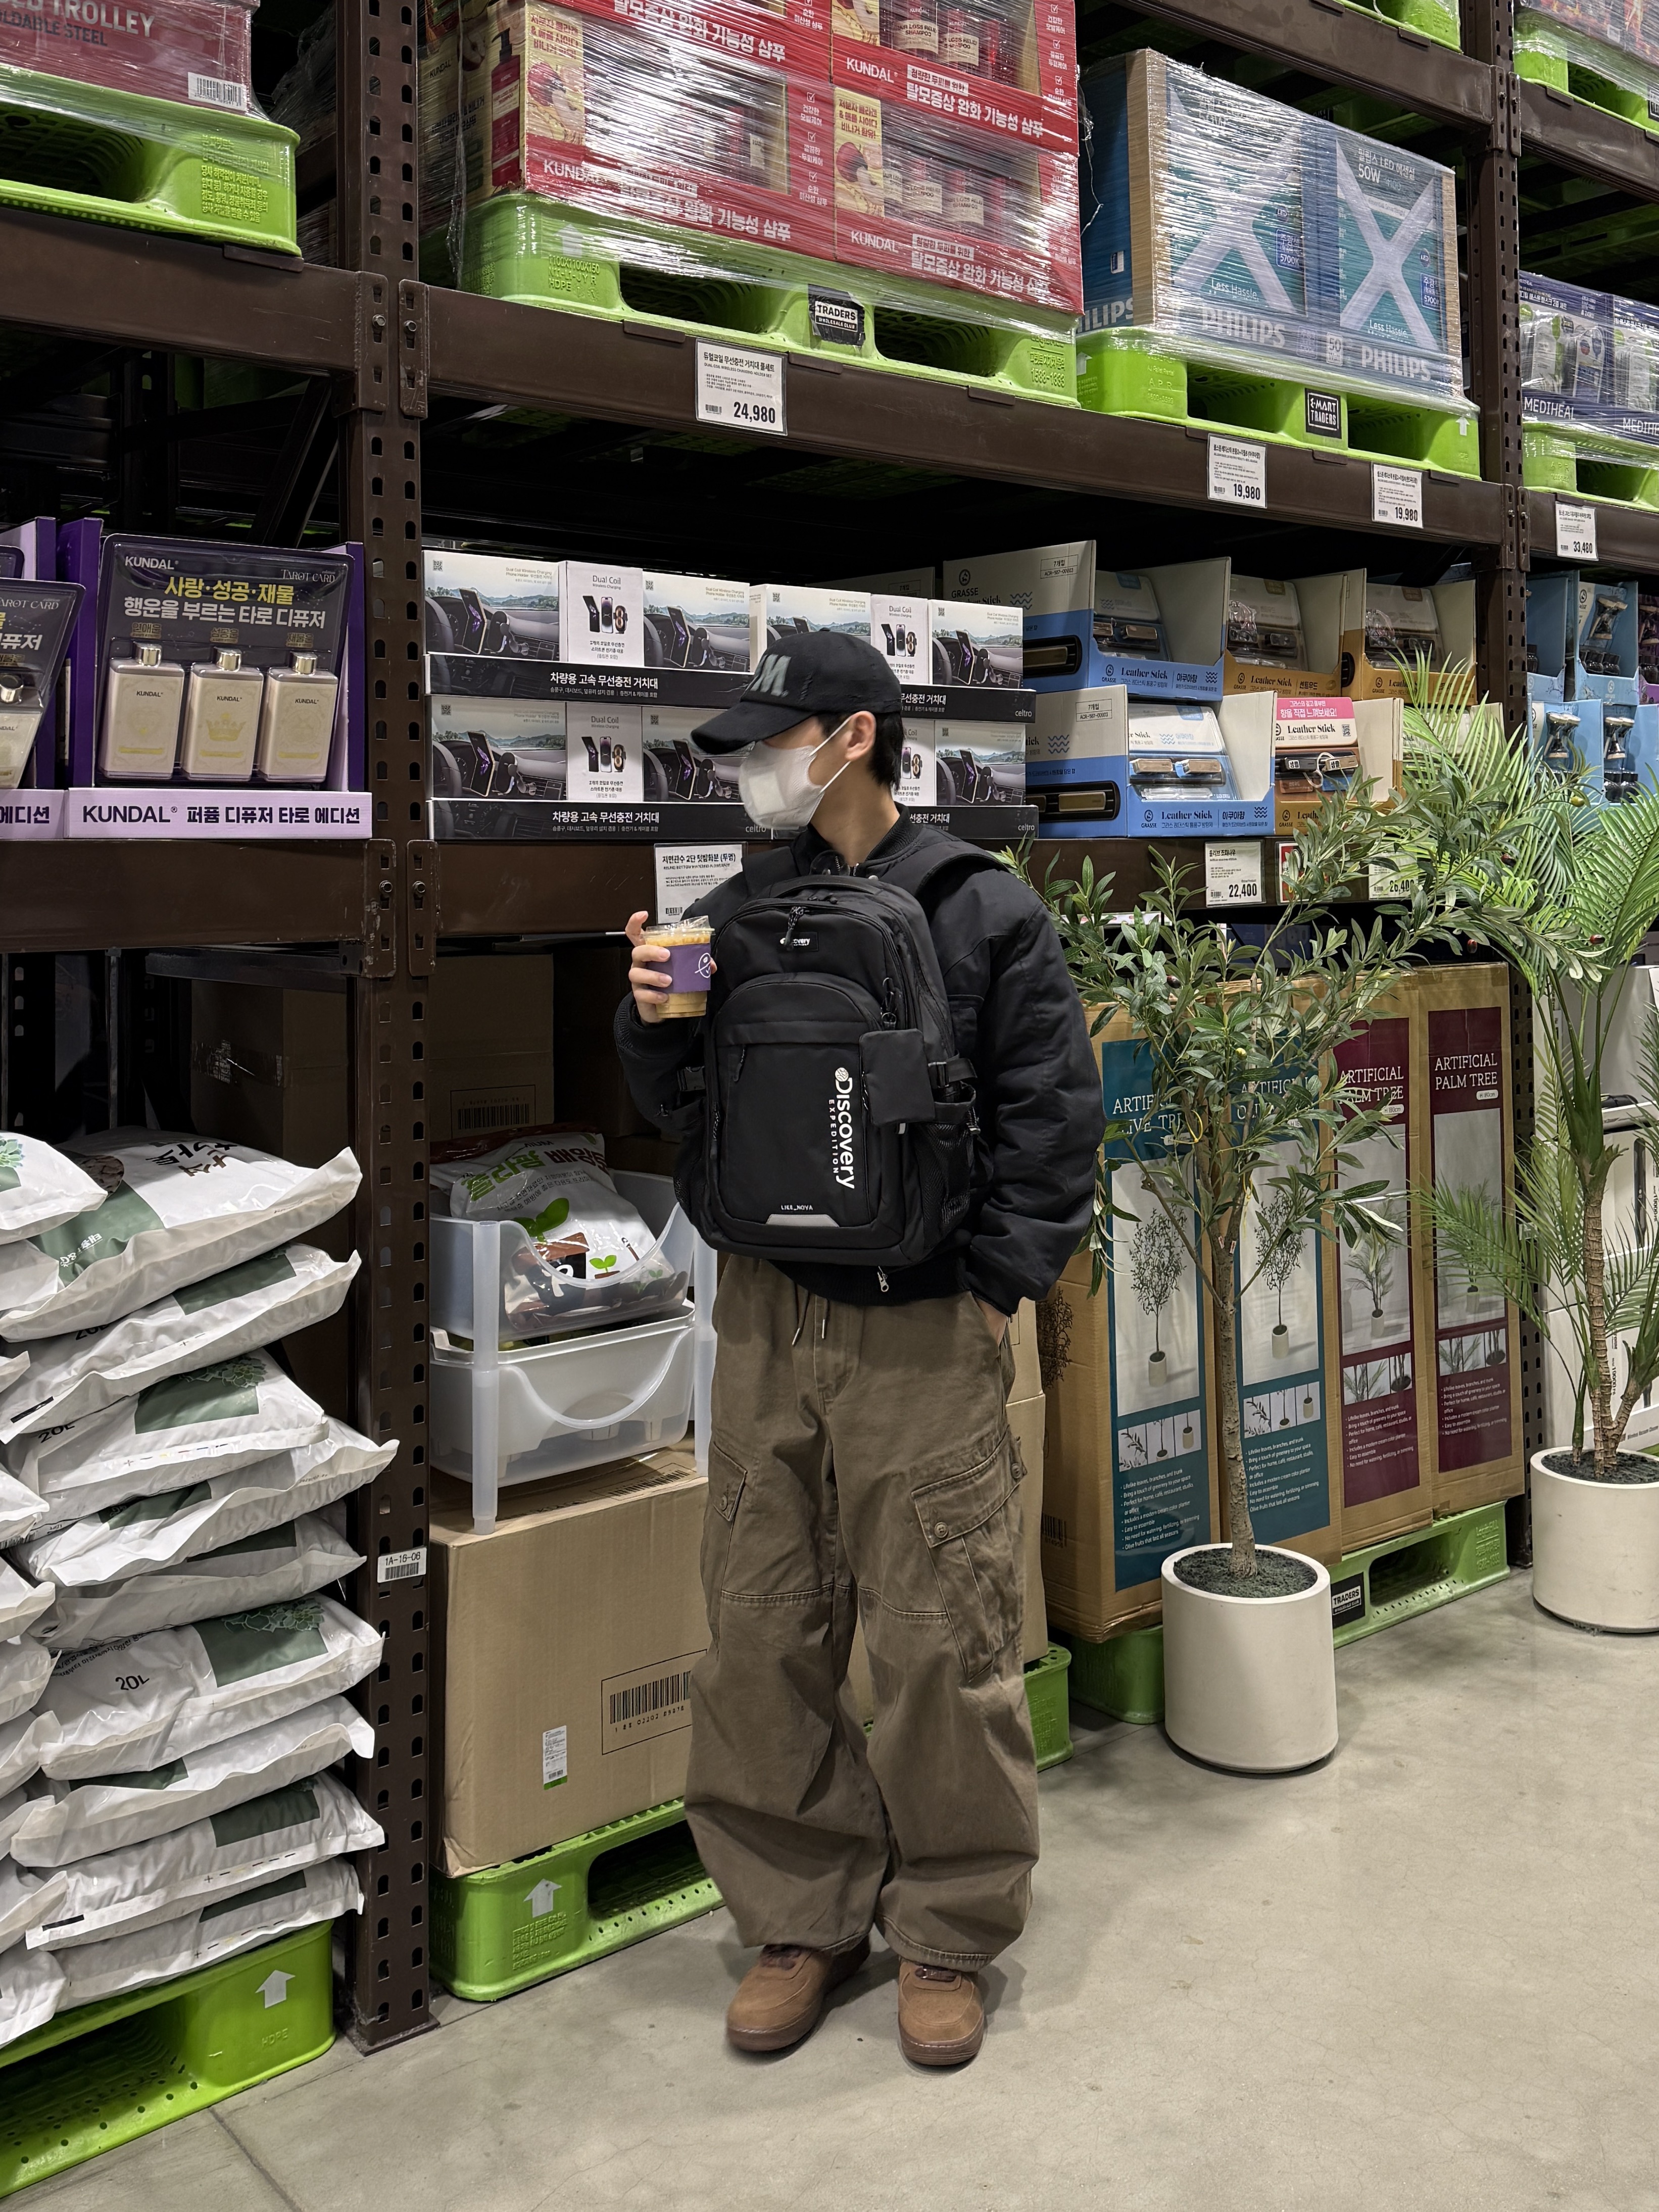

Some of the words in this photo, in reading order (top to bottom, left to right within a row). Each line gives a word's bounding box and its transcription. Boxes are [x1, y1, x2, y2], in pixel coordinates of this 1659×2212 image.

[811, 19, 823, 31] 샴푸
[64, 23, 107, 46] STEEL
[712, 22, 754, 52] 기능성
[758, 37, 786, 62] 샴푸
[846, 57, 894, 83] KUNDAL
[951, 80, 965, 93] 위한
[906, 81, 955, 111] 탈모증상
[957, 98, 982, 120] 완화
[984, 105, 1019, 132] 기능성
[1021, 114, 1044, 138] 샴푸
[1380, 158, 1394, 171] LED
[1358, 163, 1381, 183] 50W
[815, 194, 827, 207] 샴푸
[717, 207, 759, 234] 기능성
[763, 218, 791, 241] 샴푸
[1280, 253, 1299, 267] 5700K
[911, 252, 960, 279] 탈모증상
[962, 262, 988, 284] 완화
[548, 277, 572, 292] HDPE
[1211, 281, 1230, 293] Less
[816, 304, 856, 320] TRADERS
[1369, 319, 1385, 330] Less
[1328, 334, 1341, 353] 50
[704, 352, 723, 363] 듀얼코일
[724, 356, 744, 367] 무선충전
[745, 360, 759, 370] 거치대
[1361, 345, 1431, 382] PHILIPS
[734, 402, 775, 424] 24,980
[1524, 396, 1575, 421] MEDIHEAL
[1310, 410, 1336, 426] TRADERS
[1623, 417, 1659, 438] MEDIHE
[1234, 483, 1260, 500] 19,980
[1395, 507, 1418, 521] 19,980
[1574, 541, 1592, 554] 33,480
[281, 569, 310, 581] TAROT
[312, 572, 335, 583] CARD
[593, 575, 608, 583] Dual
[609, 577, 621, 585] Coil
[951, 587, 979, 598] GRASSE
[30, 600, 59, 610] CARD
[124, 596, 179, 619] 행운을
[182, 602, 236, 623] 부르는
[238, 606, 272, 625] 타로
[276, 608, 326, 630] 디퓨저
[0, 633, 42, 651] 퓨저
[1121, 667, 1149, 678] Leather
[1150, 670, 1167, 679] Stick
[1177, 673, 1198, 683] 아쿠아향
[550, 672, 577, 685] 차량용
[578, 674, 597, 686] 고속
[598, 675, 632, 688] 무선충전
[633, 678, 658, 690] 거치대
[1251, 675, 1276, 686] Leather
[1276, 677, 1292, 687] Stick
[926, 695, 946, 705] 거치대
[1014, 708, 1033, 718] celtro
[1280, 708, 1293, 718] 향을
[1294, 708, 1306, 717] 직접
[1306, 708, 1337, 717] 느껴보세요!
[1287, 724, 1316, 733] Leather
[1317, 724, 1336, 732] Stick
[187, 807, 220, 824] 퍼퓸
[224, 806, 274, 824] 디퓨저
[278, 807, 310, 824] 타로
[314, 807, 360, 825] 에디션
[552, 811, 579, 822] 차량용
[580, 812, 598, 822] 고속
[600, 812, 632, 823] 무선충전
[635, 812, 659, 823] 거치대
[930, 813, 950, 823] 거치대
[1161, 810, 1192, 820] Leather
[1193, 811, 1212, 819] Stick
[1222, 811, 1245, 820] 아쿠아향
[746, 821, 766, 833] celtro
[1018, 823, 1035, 831] celtro
[687, 855, 696, 863] 2단
[1229, 883, 1257, 899] 22,400
[1434, 1053, 1498, 1071] ARTIFICIAL
[1339, 1066, 1404, 1085] ARTIFICIAL
[1435, 1074, 1467, 1091] PALM
[1469, 1072, 1497, 1087] TREE
[828, 1099, 839, 1173] EXPEDITION
[386, 1552, 420, 1566] 1A-16-06
[1333, 1589, 1359, 1605] TRADERS
[115, 1674, 150, 1691] 20L
[261, 2028, 289, 2049] HDPE
